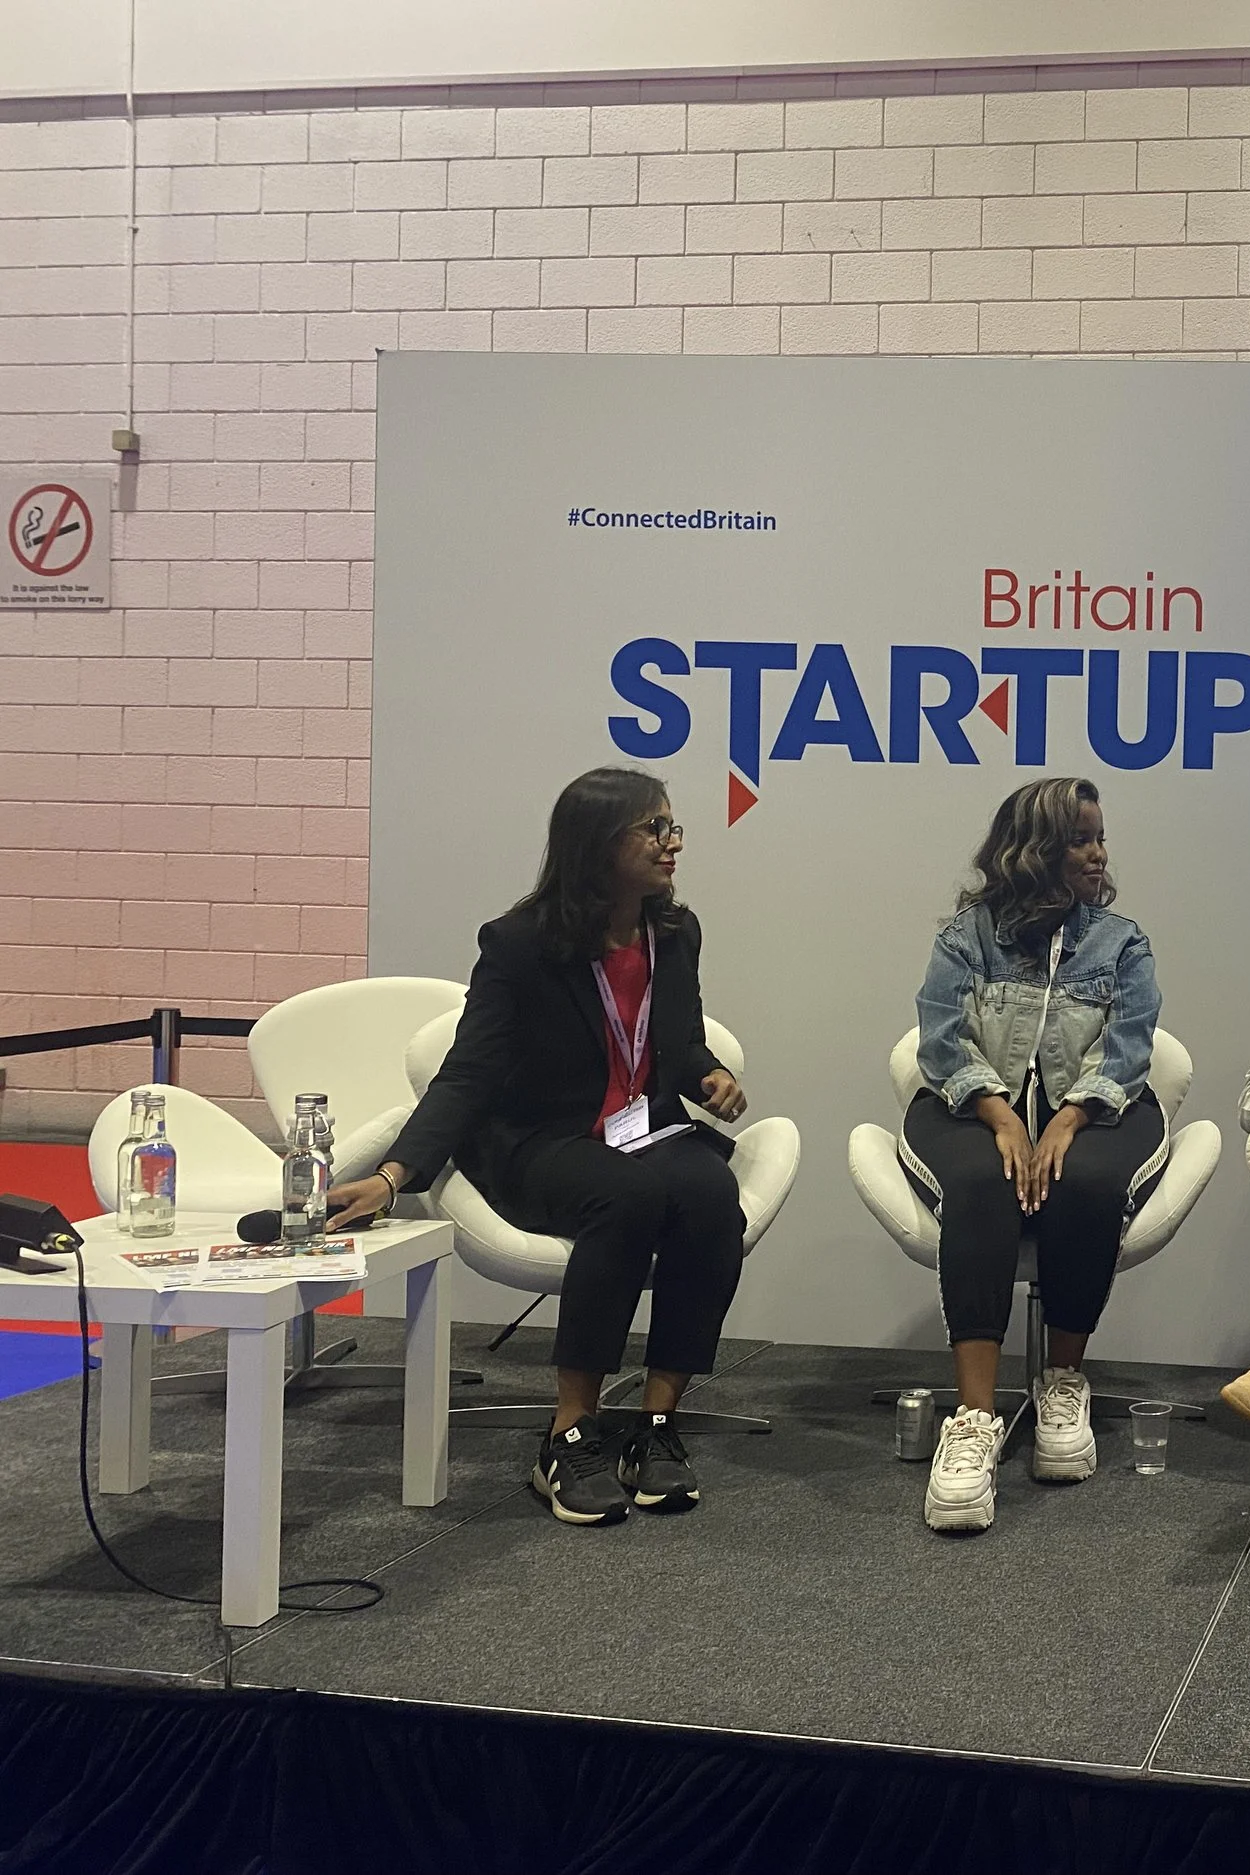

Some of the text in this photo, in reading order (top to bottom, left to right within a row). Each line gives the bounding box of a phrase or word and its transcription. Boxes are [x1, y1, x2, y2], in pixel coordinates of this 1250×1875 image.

[567, 507, 777, 531] #ConnectedBritain
[29, 585, 59, 593] against
[88, 596, 105, 604] way
[982, 568, 1204, 633] Britain
